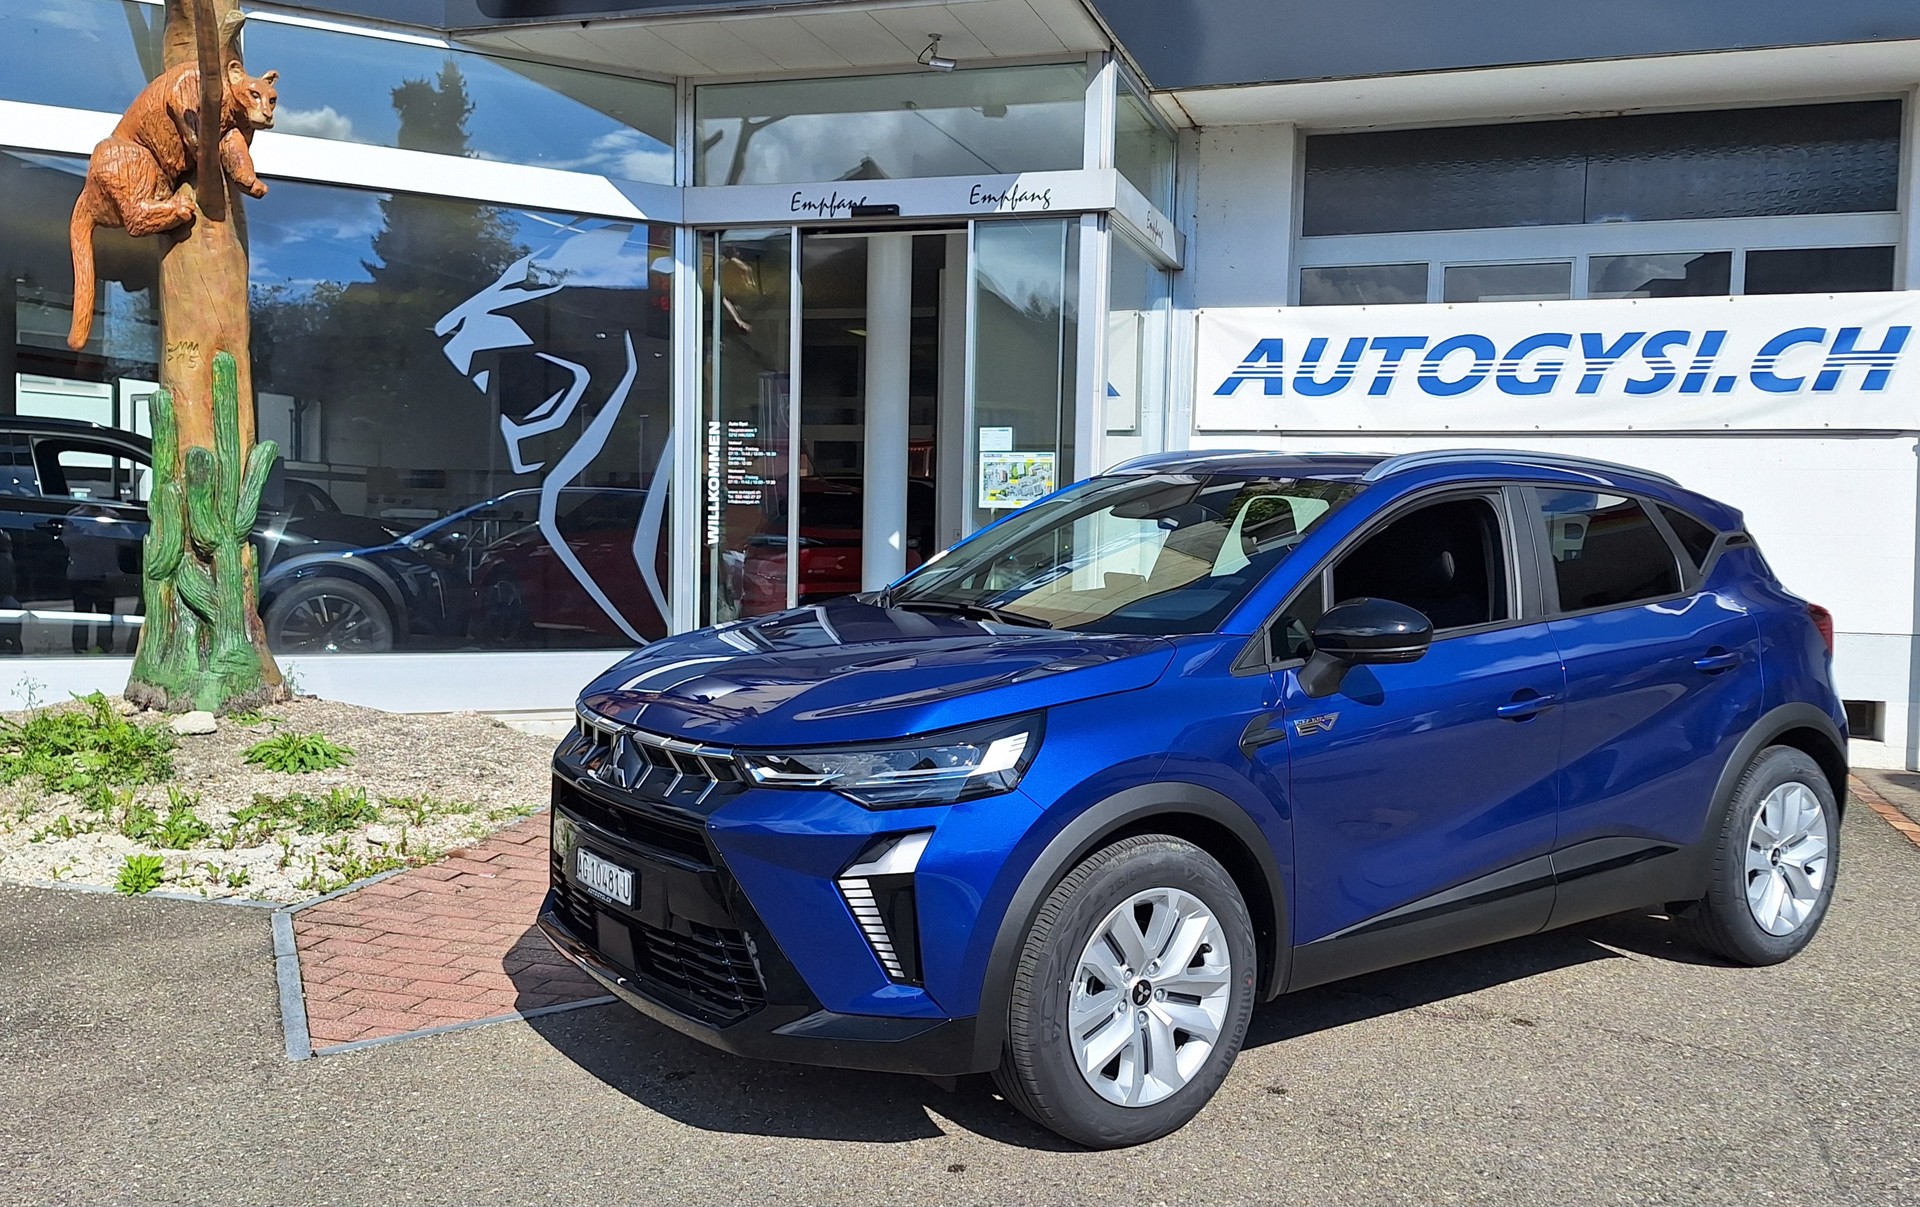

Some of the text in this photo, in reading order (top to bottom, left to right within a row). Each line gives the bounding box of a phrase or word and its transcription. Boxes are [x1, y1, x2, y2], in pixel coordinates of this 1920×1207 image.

[969, 184, 1051, 211] Empfang
[1212, 326, 1913, 397] AUTOGYSI.CH
[707, 421, 720, 545] WILLKOMMEN
